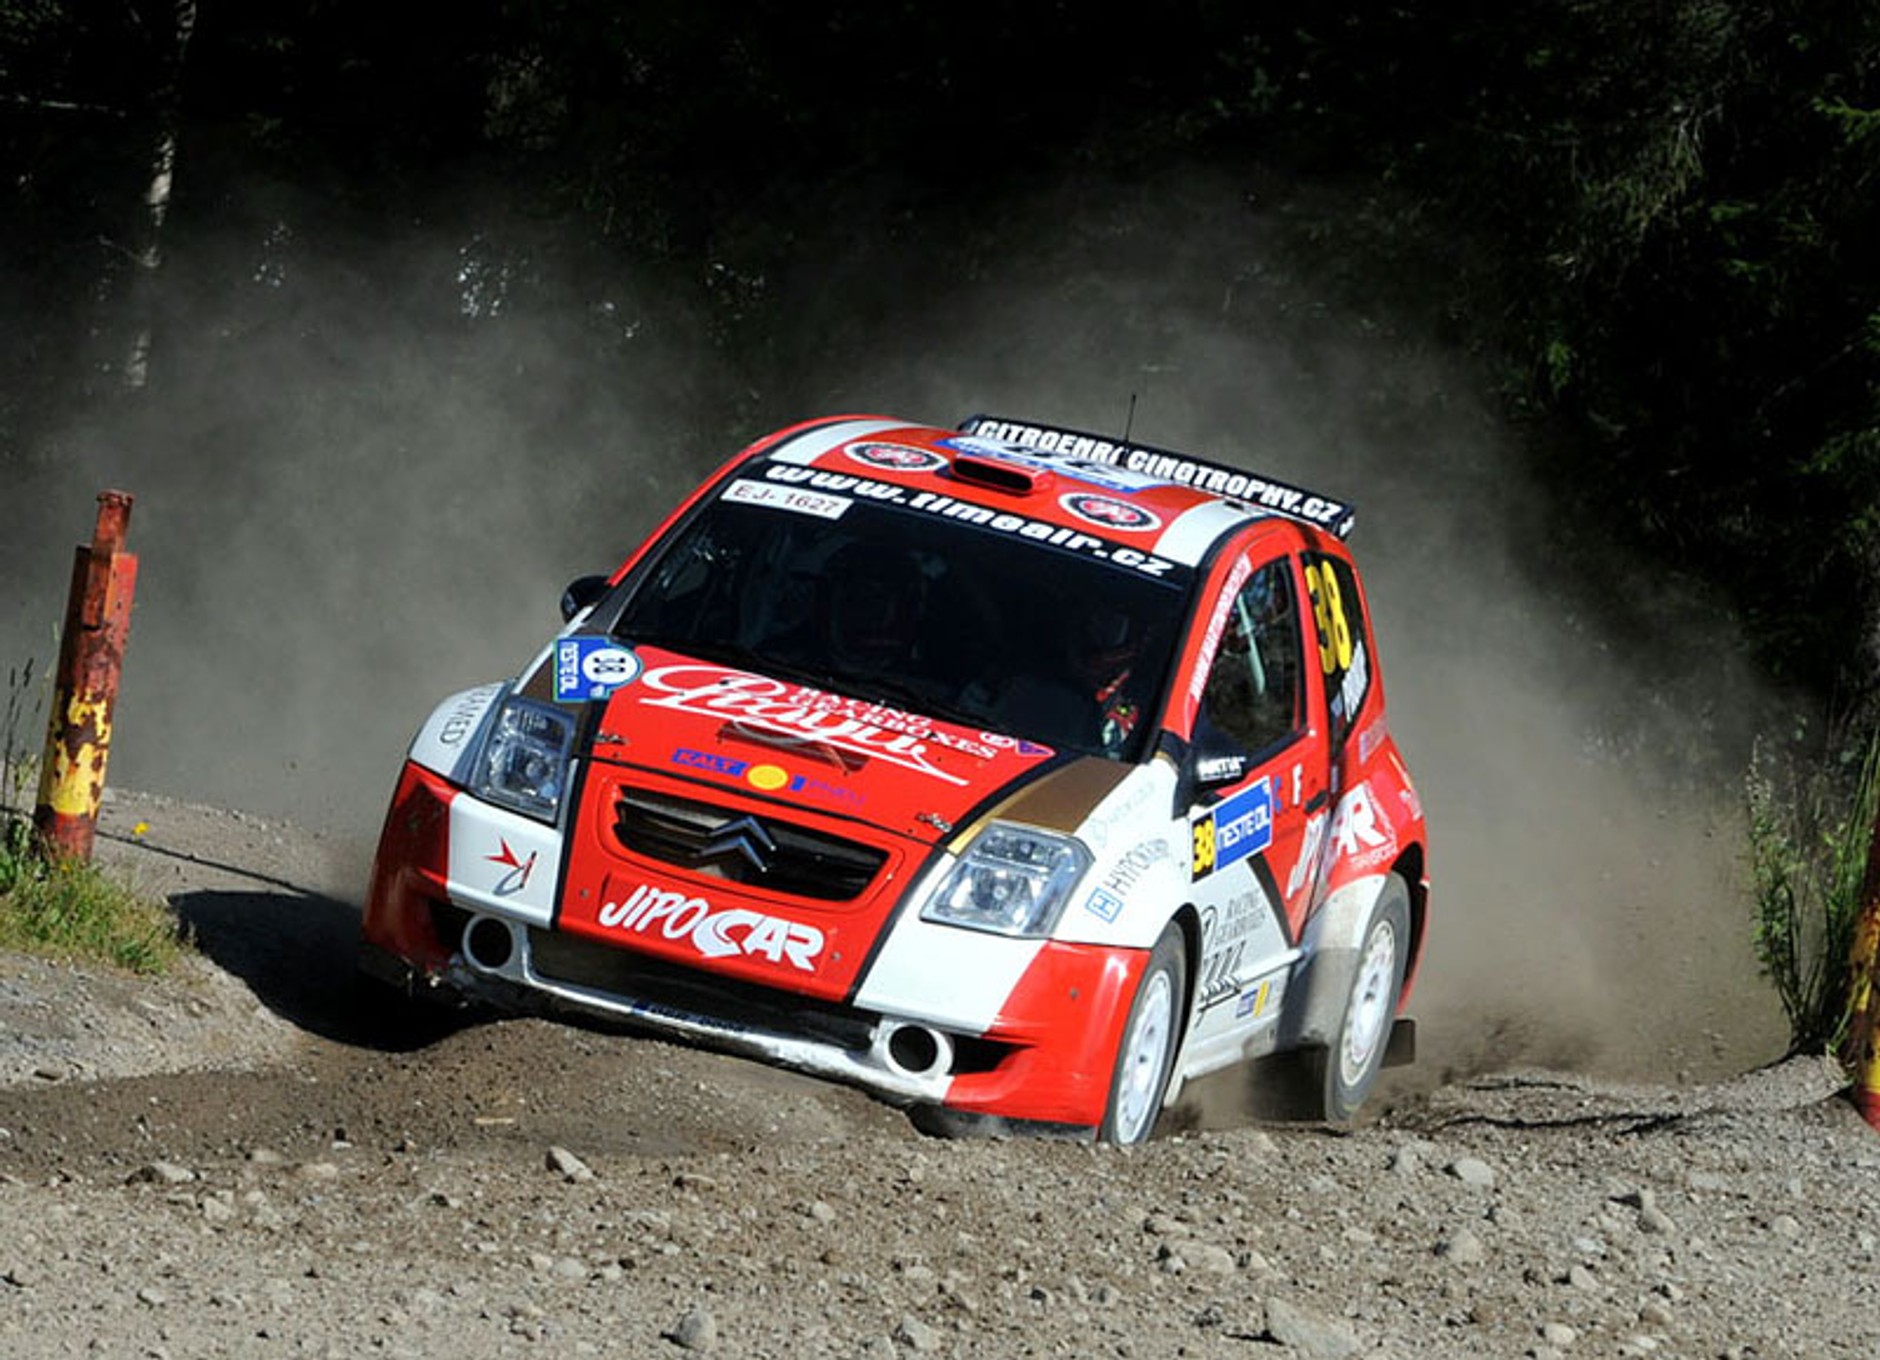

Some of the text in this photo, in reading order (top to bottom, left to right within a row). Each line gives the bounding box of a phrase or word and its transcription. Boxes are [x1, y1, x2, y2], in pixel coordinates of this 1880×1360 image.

[1304, 560, 1351, 675] 38
[1193, 819, 1216, 874] 38
[598, 883, 825, 972] JIPOCAR
